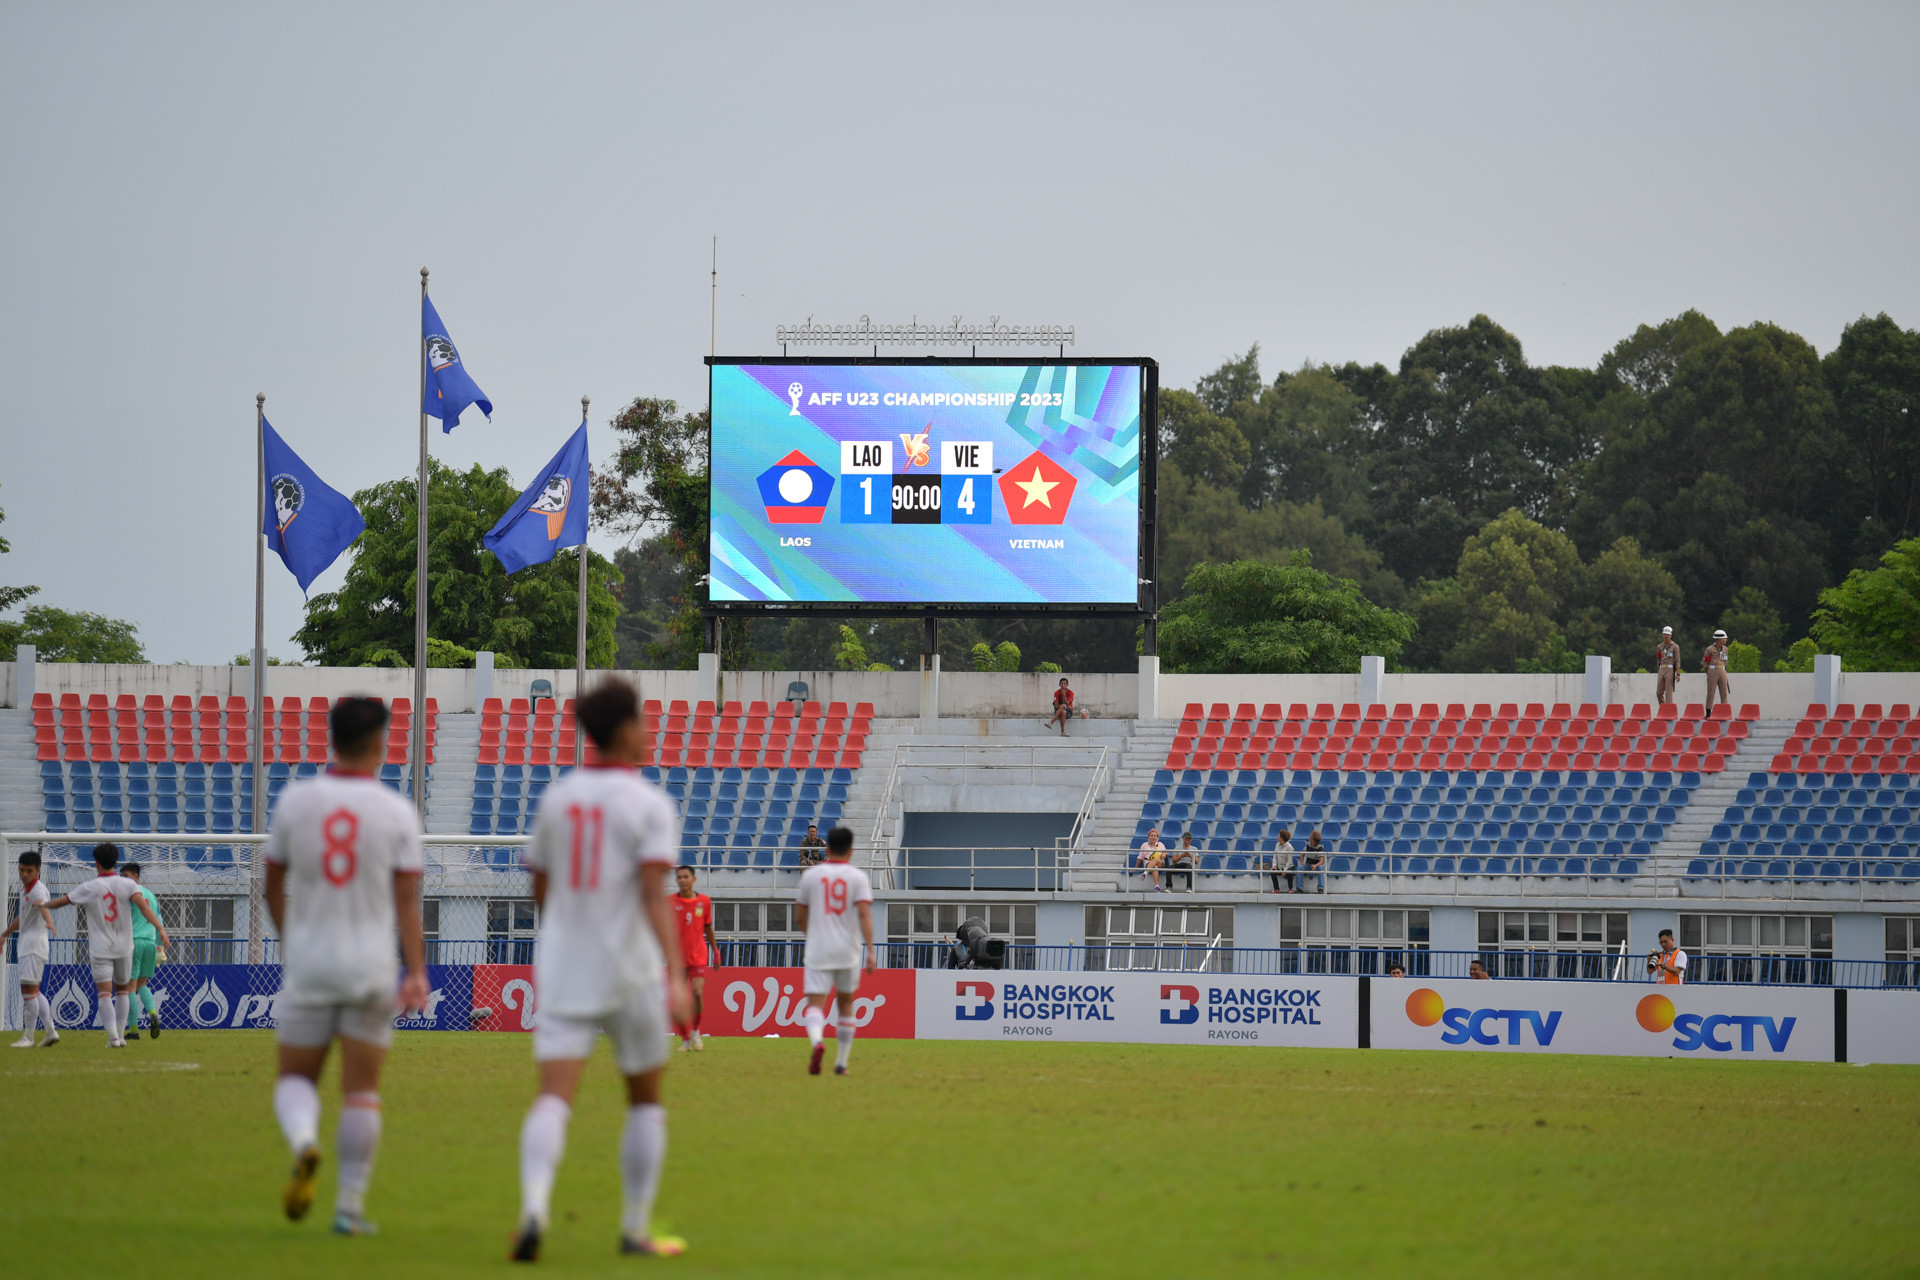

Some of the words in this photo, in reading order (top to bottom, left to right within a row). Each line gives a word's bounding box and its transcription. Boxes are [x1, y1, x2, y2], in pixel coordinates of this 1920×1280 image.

[808, 392, 843, 406] AFF
[847, 392, 879, 406] U23
[883, 392, 1017, 406] CHAMPIONSHIP
[1019, 392, 1063, 406] 2023
[852, 444, 882, 467] LAO
[899, 433, 931, 467] VS
[954, 445, 979, 468] VIE
[859, 477, 872, 515] 1
[892, 485, 941, 510] 90:00
[957, 477, 976, 515] 4
[780, 537, 811, 548] LAOS
[1009, 539, 1064, 550] VIETNAM
[322, 806, 358, 888] 8
[567, 803, 606, 891] 11
[102, 891, 118, 923] 3
[820, 876, 848, 916] 19
[685, 912, 693, 926] 9
[1003, 984, 1115, 1003] BANGKOK
[1208, 987, 1321, 1007] BANGKOK
[230, 994, 282, 1027] pt
[1003, 1002, 1115, 1021] HOSPITAL
[1208, 1006, 1321, 1025] HOSPITAL
[394, 1017, 437, 1030] Group
[1002, 1026, 1053, 1036] RAYONG
[1208, 1029, 1259, 1040] RAYONG
[1440, 1007, 1563, 1046] SCTV
[1672, 1013, 1797, 1052] SCTV
